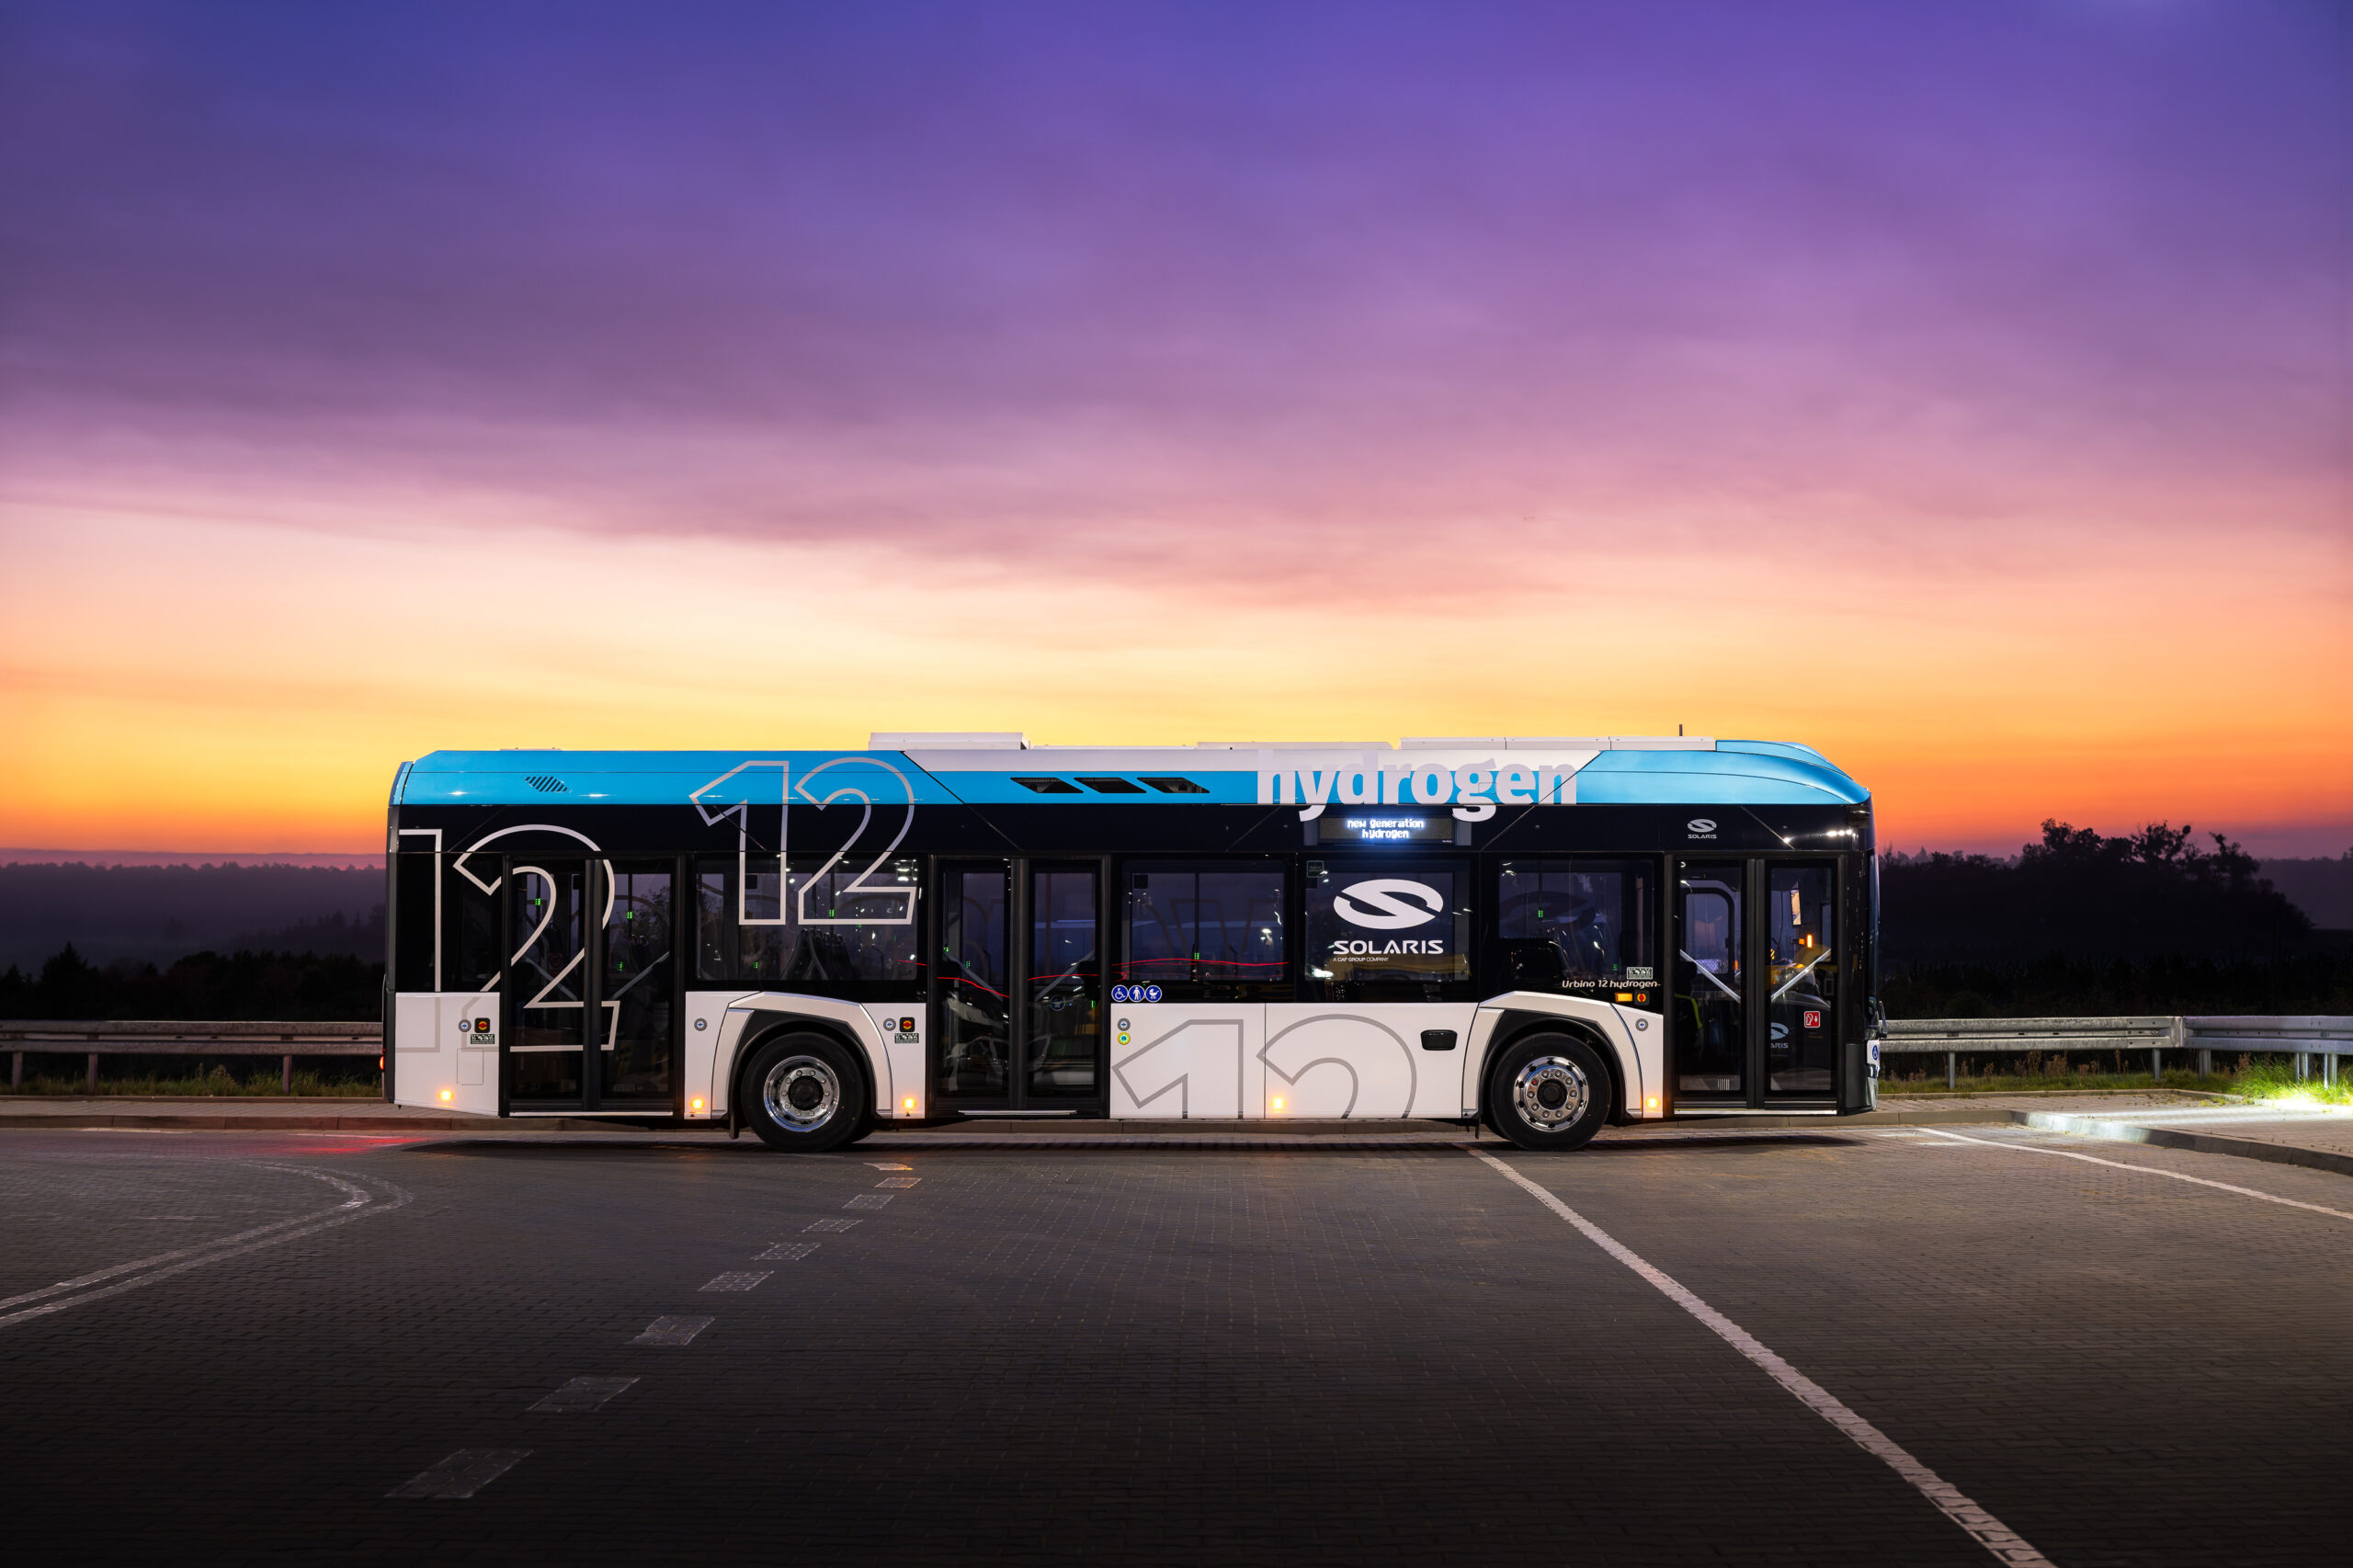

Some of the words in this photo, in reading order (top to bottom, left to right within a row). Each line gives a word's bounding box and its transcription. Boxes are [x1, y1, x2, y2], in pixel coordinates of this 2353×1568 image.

[1256, 749, 1577, 823] hydrogen
[1347, 819, 1367, 828] new
[1370, 818, 1425, 828] generation
[1361, 828, 1410, 838] hydrogen
[689, 756, 917, 925] 12
[1333, 939, 1444, 955] SOLARIS
[1562, 979, 1596, 988] Urbino
[1597, 979, 1608, 988] 12
[1609, 979, 1658, 989] hydrogen
